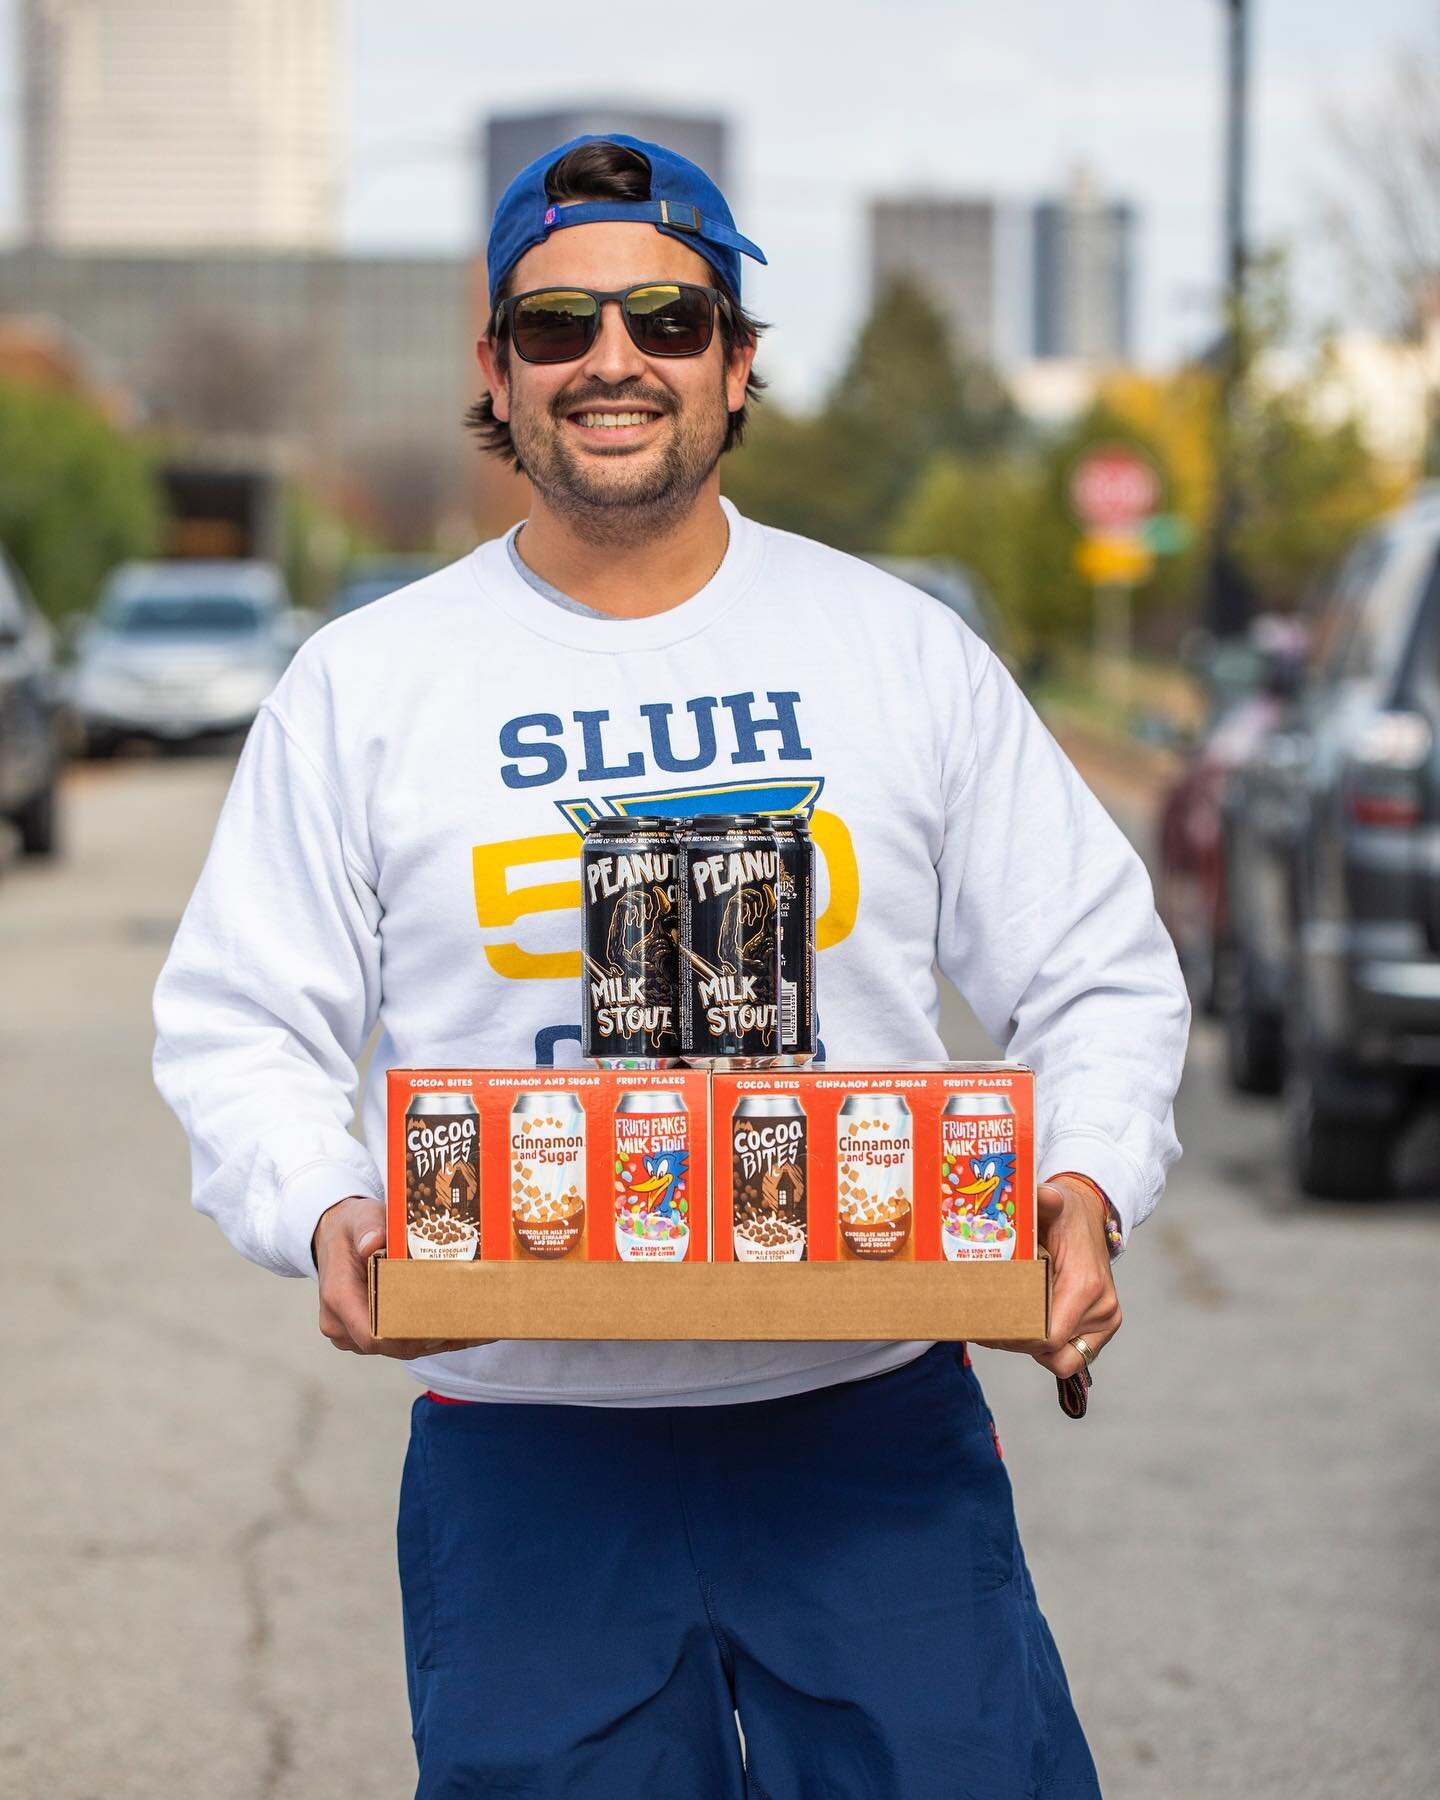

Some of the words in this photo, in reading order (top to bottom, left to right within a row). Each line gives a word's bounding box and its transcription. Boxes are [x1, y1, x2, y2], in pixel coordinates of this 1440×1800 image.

[499, 691, 812, 789] SLUH
[590, 975, 647, 1010] MILK
[698, 975, 758, 1010] MILK
[597, 1005, 673, 1037] STOUT
[706, 1004, 778, 1037] STOUT
[409, 1079, 444, 1088] COCOA
[447, 1079, 473, 1087] BITES
[488, 1078, 542, 1087] CINNAMON
[544, 1077, 566, 1086] AND
[568, 1077, 600, 1086] SUGAR
[616, 1077, 648, 1085] FRUITY
[651, 1076, 686, 1085] FLAKES
[736, 1081, 771, 1089] COCOA
[774, 1080, 800, 1088] BITES
[815, 1080, 868, 1088] CINNAMON
[871, 1080, 893, 1088] AND
[895, 1079, 928, 1087] SUGAR
[943, 1079, 976, 1087] FRUITY
[978, 1078, 1013, 1087] FLAKES
[651, 1116, 687, 1135] FLAKES
[978, 1118, 1013, 1137] FLAKES
[512, 1135, 583, 1149] Cinnamon
[651, 1135, 686, 1152] STOUT
[839, 1137, 910, 1151] Cinnamon
[978, 1137, 1013, 1154] STOUT
[414, 1139, 471, 1178] BITES
[520, 1151, 536, 1160] and
[539, 1150, 578, 1165] Sugar
[741, 1140, 798, 1180] BITES
[847, 1152, 863, 1162] and
[865, 1151, 905, 1167] Sugar
